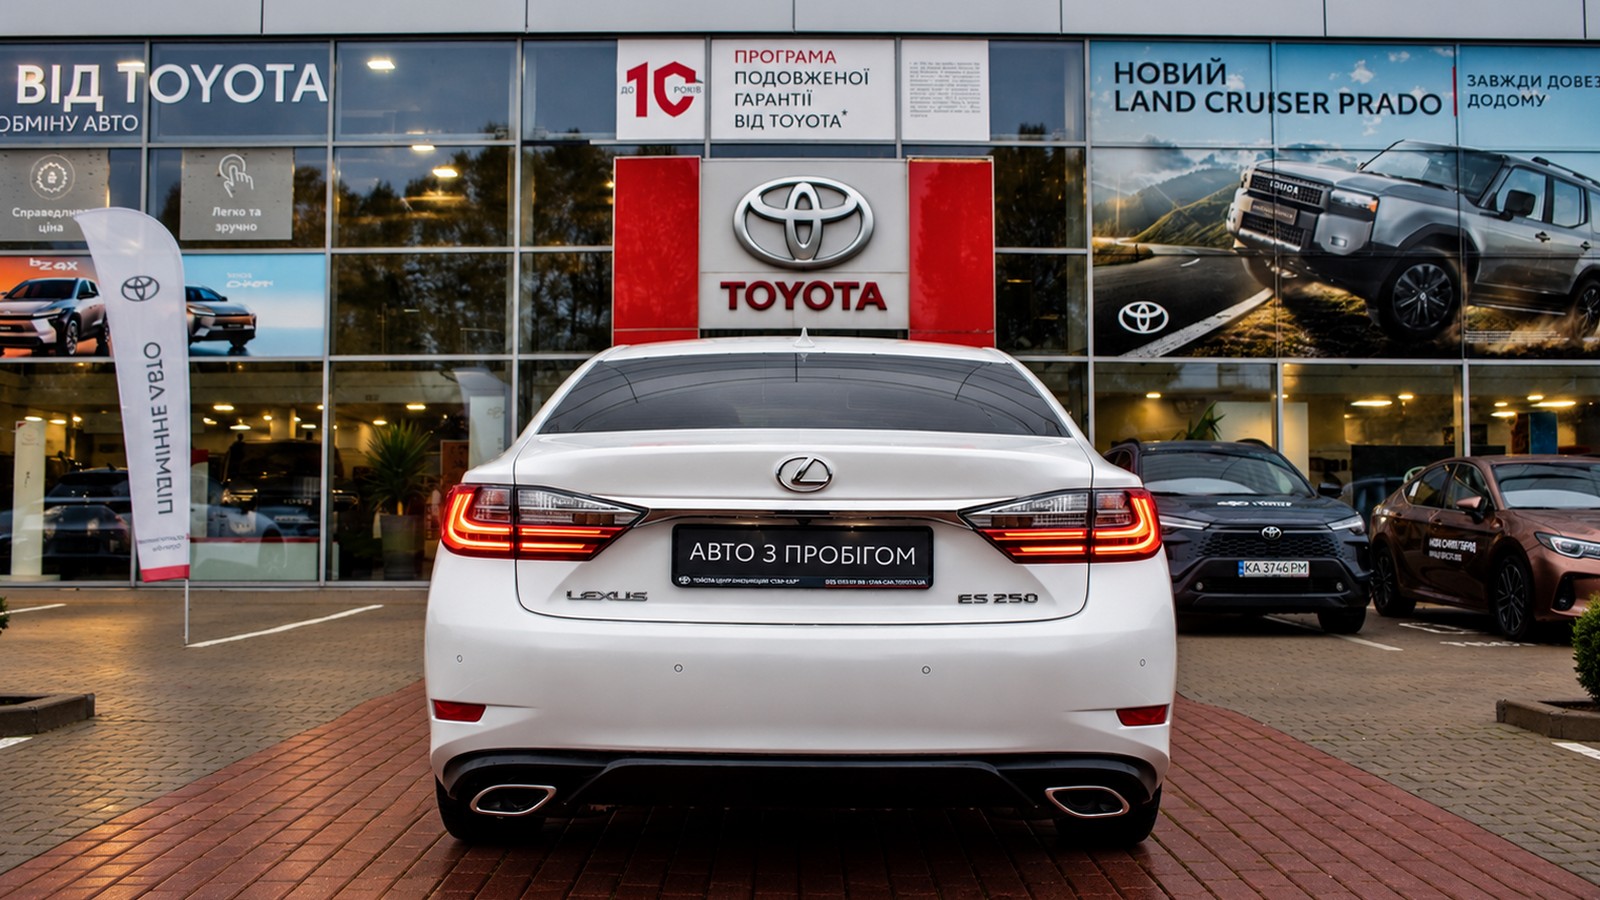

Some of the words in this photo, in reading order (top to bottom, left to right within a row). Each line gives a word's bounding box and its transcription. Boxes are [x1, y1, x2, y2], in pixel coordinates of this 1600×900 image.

[734, 50, 836, 64] ПРОГРАМА
[734, 69, 870, 87] ПОДОВЖЕНОЇ
[1114, 58, 1227, 85] НОВИЙ
[17, 64, 104, 112] ВІД
[117, 60, 328, 104] TOYOTA
[1467, 74, 1542, 90] ЗАВЖДИ
[621, 86, 635, 95] ДО
[734, 92, 813, 107] ГАРАНТІЇ
[1114, 91, 1196, 113] LAND
[1205, 91, 1329, 115] CRUISER
[1339, 93, 1442, 115] PRADO
[1467, 94, 1546, 109] ДОДОМУ
[83, 115, 139, 132] АВТО
[734, 114, 765, 131] ВІД
[212, 206, 246, 217] Легко
[249, 208, 262, 217] та
[38, 222, 64, 234] ціна
[215, 223, 258, 234] зручно
[720, 281, 888, 311] TOYOTA
[689, 543, 755, 565] АВТО
[763, 544, 777, 564] З
[785, 544, 916, 566] ПРОБІГОМ
[1263, 563, 1289, 573] 3746
[566, 590, 648, 602] LEXUS
[957, 594, 989, 604] ES
[993, 593, 1039, 604] 250
